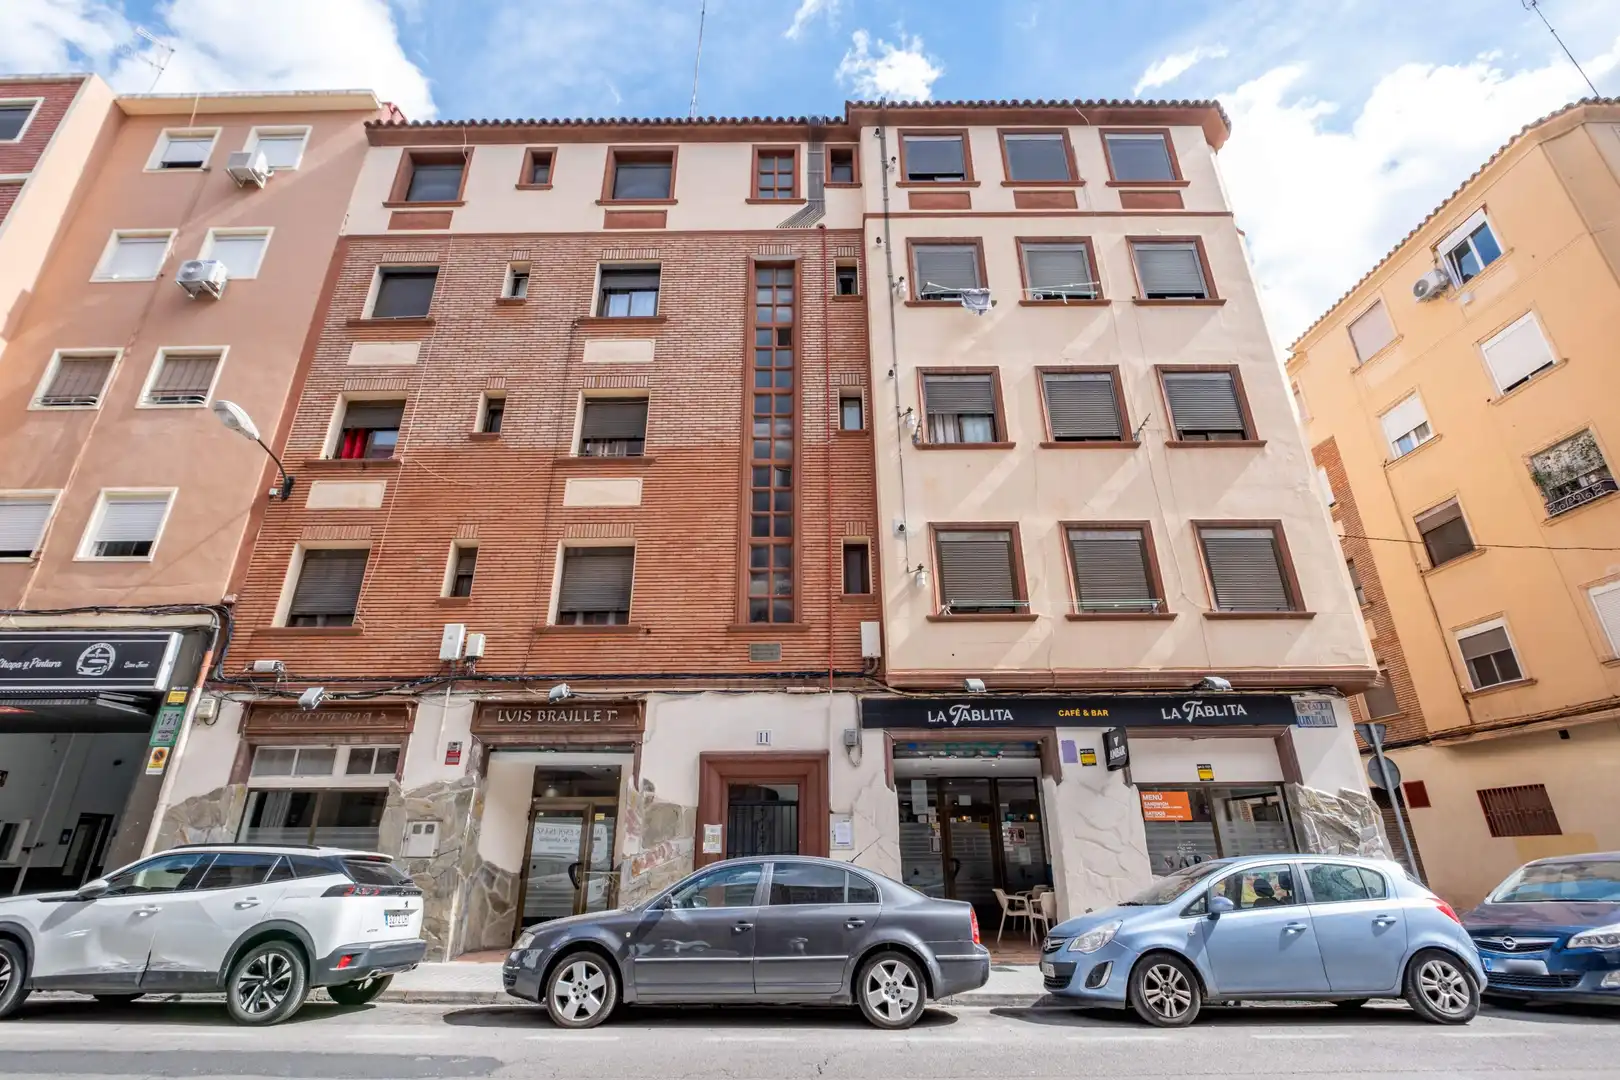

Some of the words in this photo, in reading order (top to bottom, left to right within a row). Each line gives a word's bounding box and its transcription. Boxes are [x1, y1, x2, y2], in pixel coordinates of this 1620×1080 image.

[22, 661, 30, 670] y
[29, 657, 62, 669] Pintura
[537, 709, 601, 722] BRAILLE
[927, 710, 947, 723] LA
[949, 704, 1014, 726] TABLITA
[1058, 708, 1081, 717] CAFÉ
[1083, 709, 1090, 717] &
[1091, 709, 1109, 717] BAR
[1161, 708, 1181, 720] LA
[1182, 701, 1248, 723] TABLITA
[759, 732, 769, 743] 11
